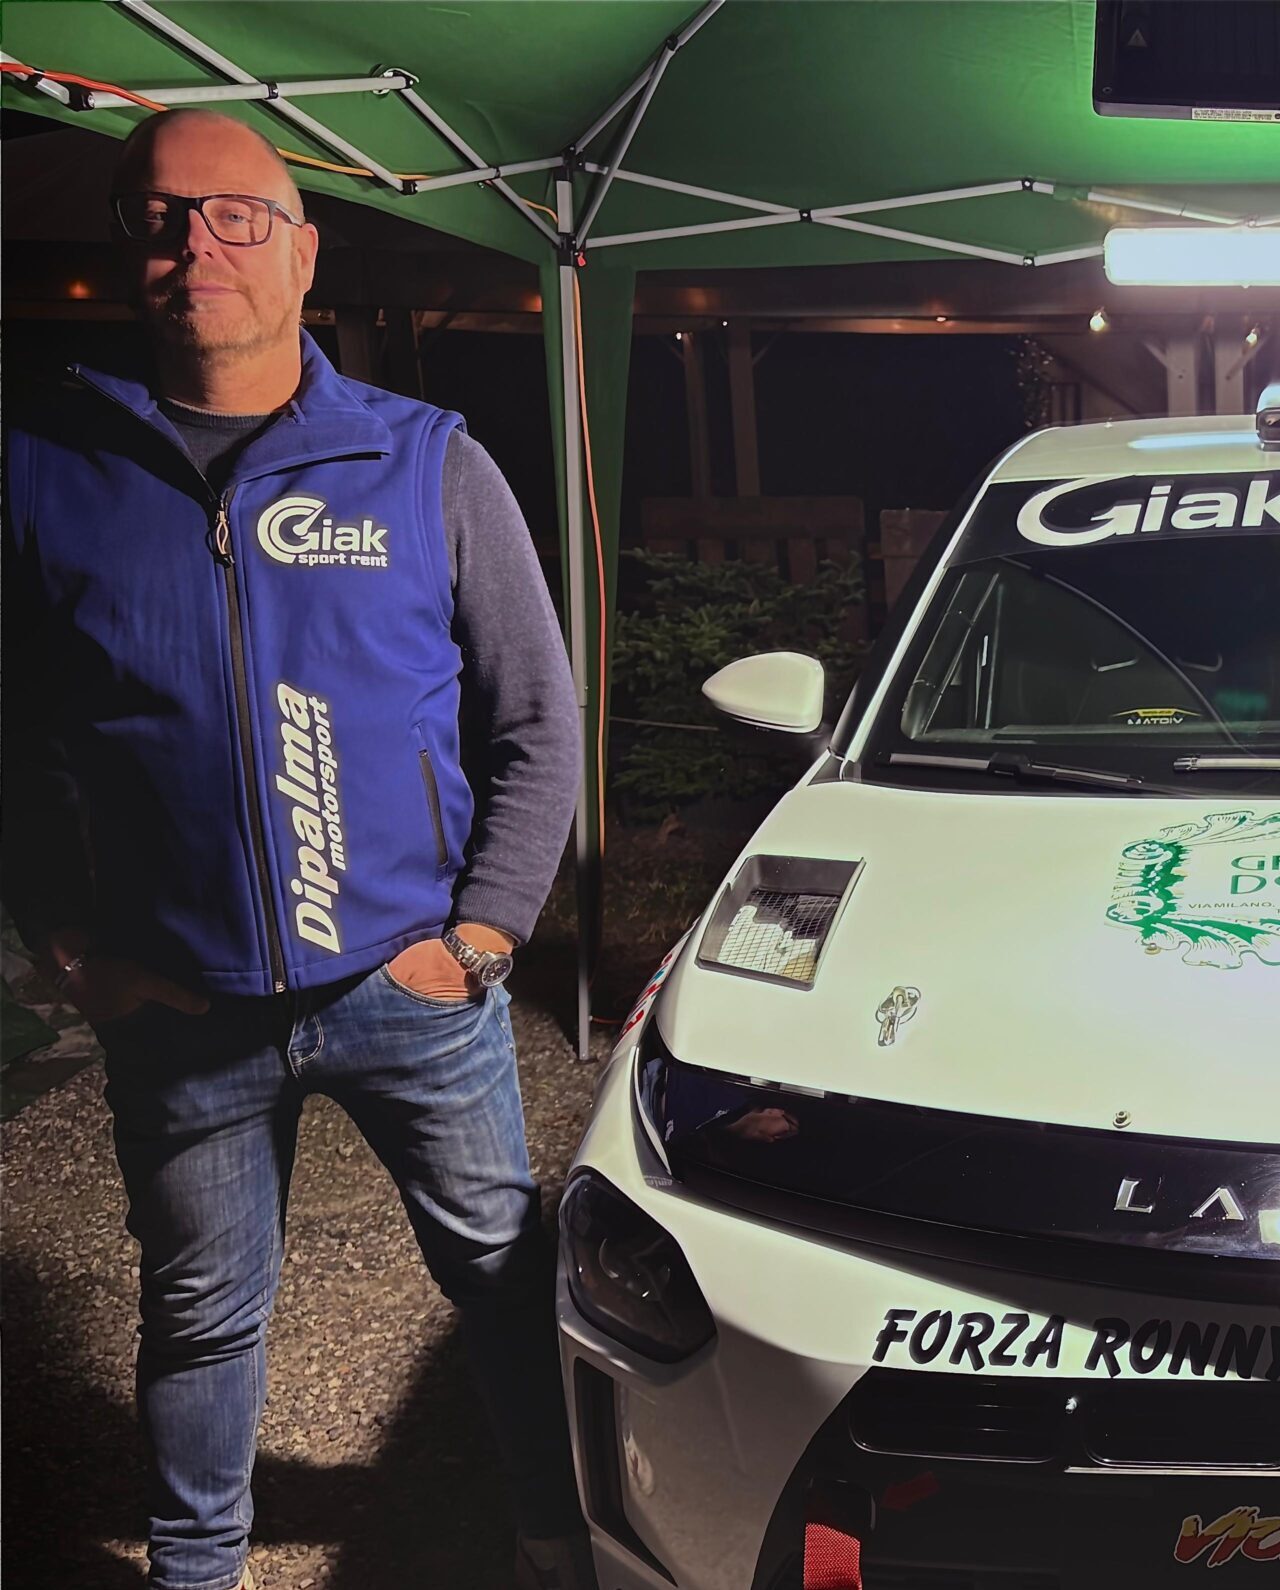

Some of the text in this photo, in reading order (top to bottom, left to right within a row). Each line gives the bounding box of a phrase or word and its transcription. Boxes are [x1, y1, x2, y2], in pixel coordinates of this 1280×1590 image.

[256, 496, 388, 564] Giak
[298, 552, 388, 567] sport rent
[308, 696, 347, 871] motorsport
[275, 683, 341, 954] Dipalma
[871, 1308, 1068, 1372] FORZA
